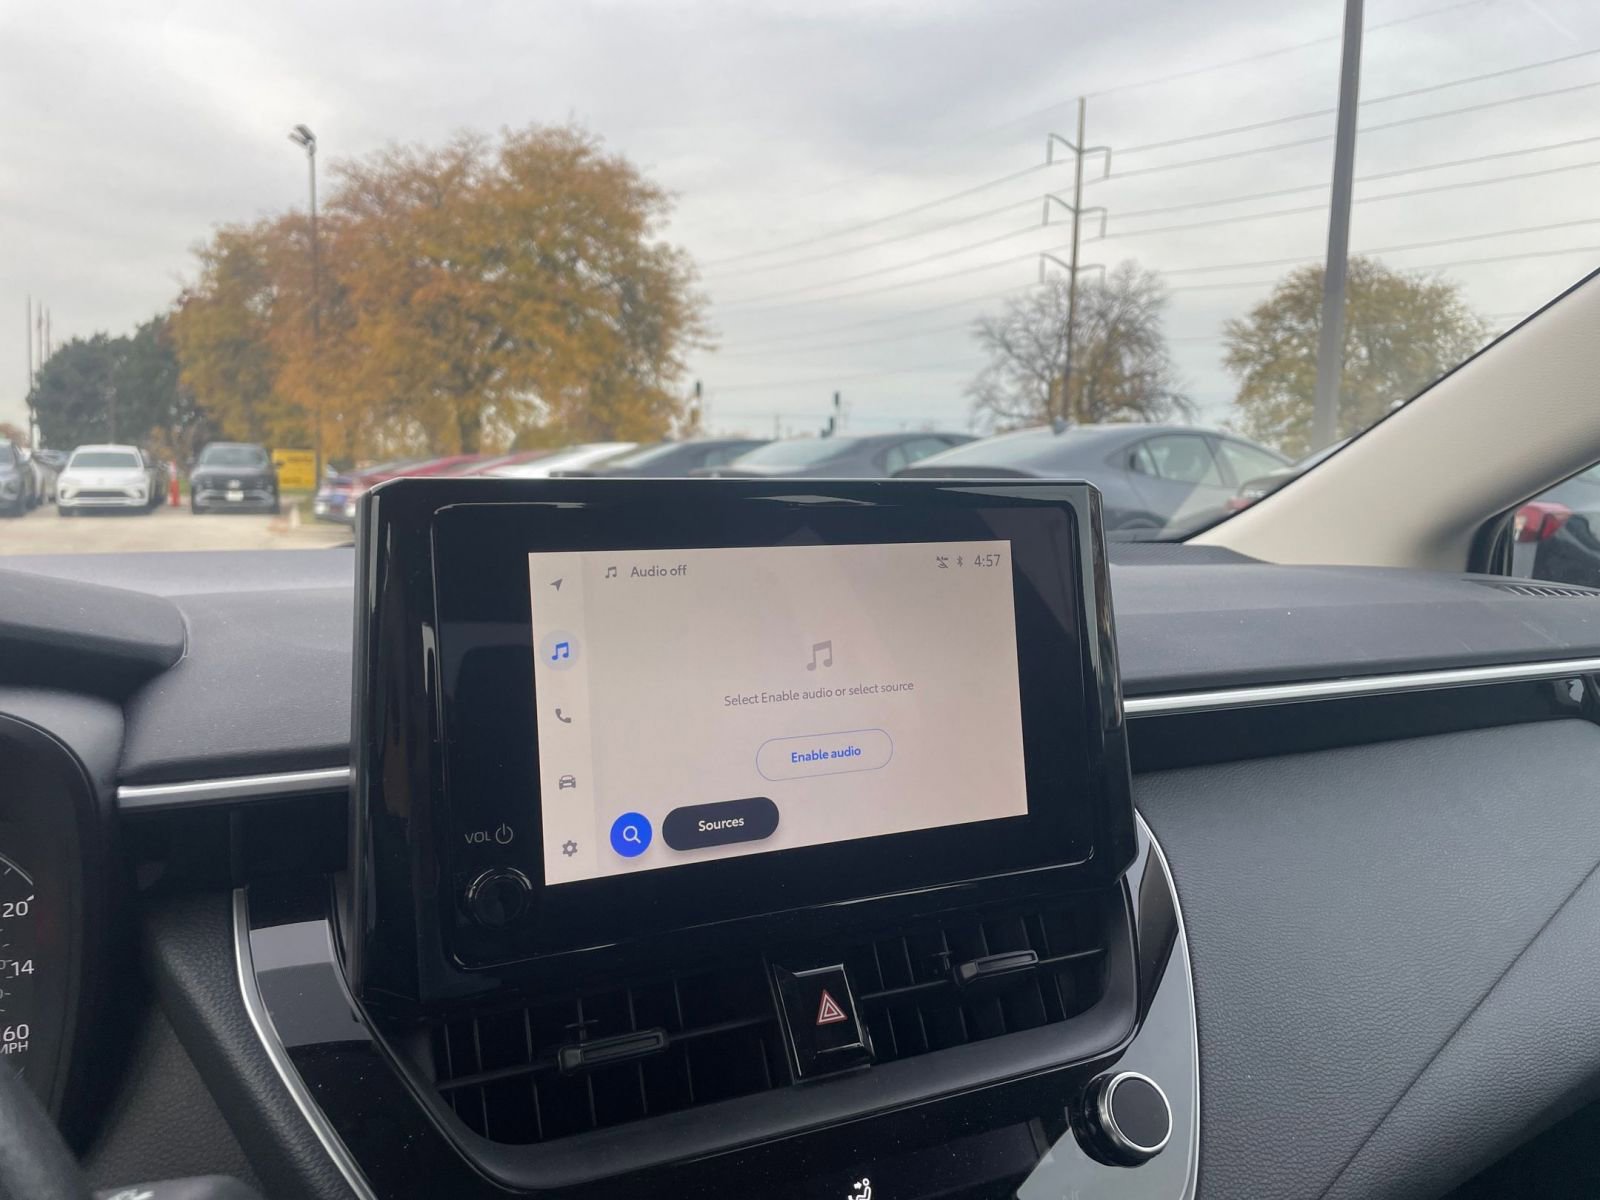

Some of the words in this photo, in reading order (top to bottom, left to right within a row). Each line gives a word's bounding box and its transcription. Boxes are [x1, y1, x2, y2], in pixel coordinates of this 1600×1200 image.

[973, 553, 1001, 568] 4:57
[630, 564, 668, 578] Audio
[669, 563, 688, 577] off
[723, 693, 760, 707] Select
[761, 689, 800, 704] Enable
[802, 686, 833, 700] audio
[834, 687, 847, 697] or
[848, 682, 879, 696] select
[880, 681, 914, 693] source
[791, 748, 829, 763] Enable
[830, 744, 862, 759] audio
[698, 817, 745, 832] Sources
[464, 830, 492, 844] VOL
